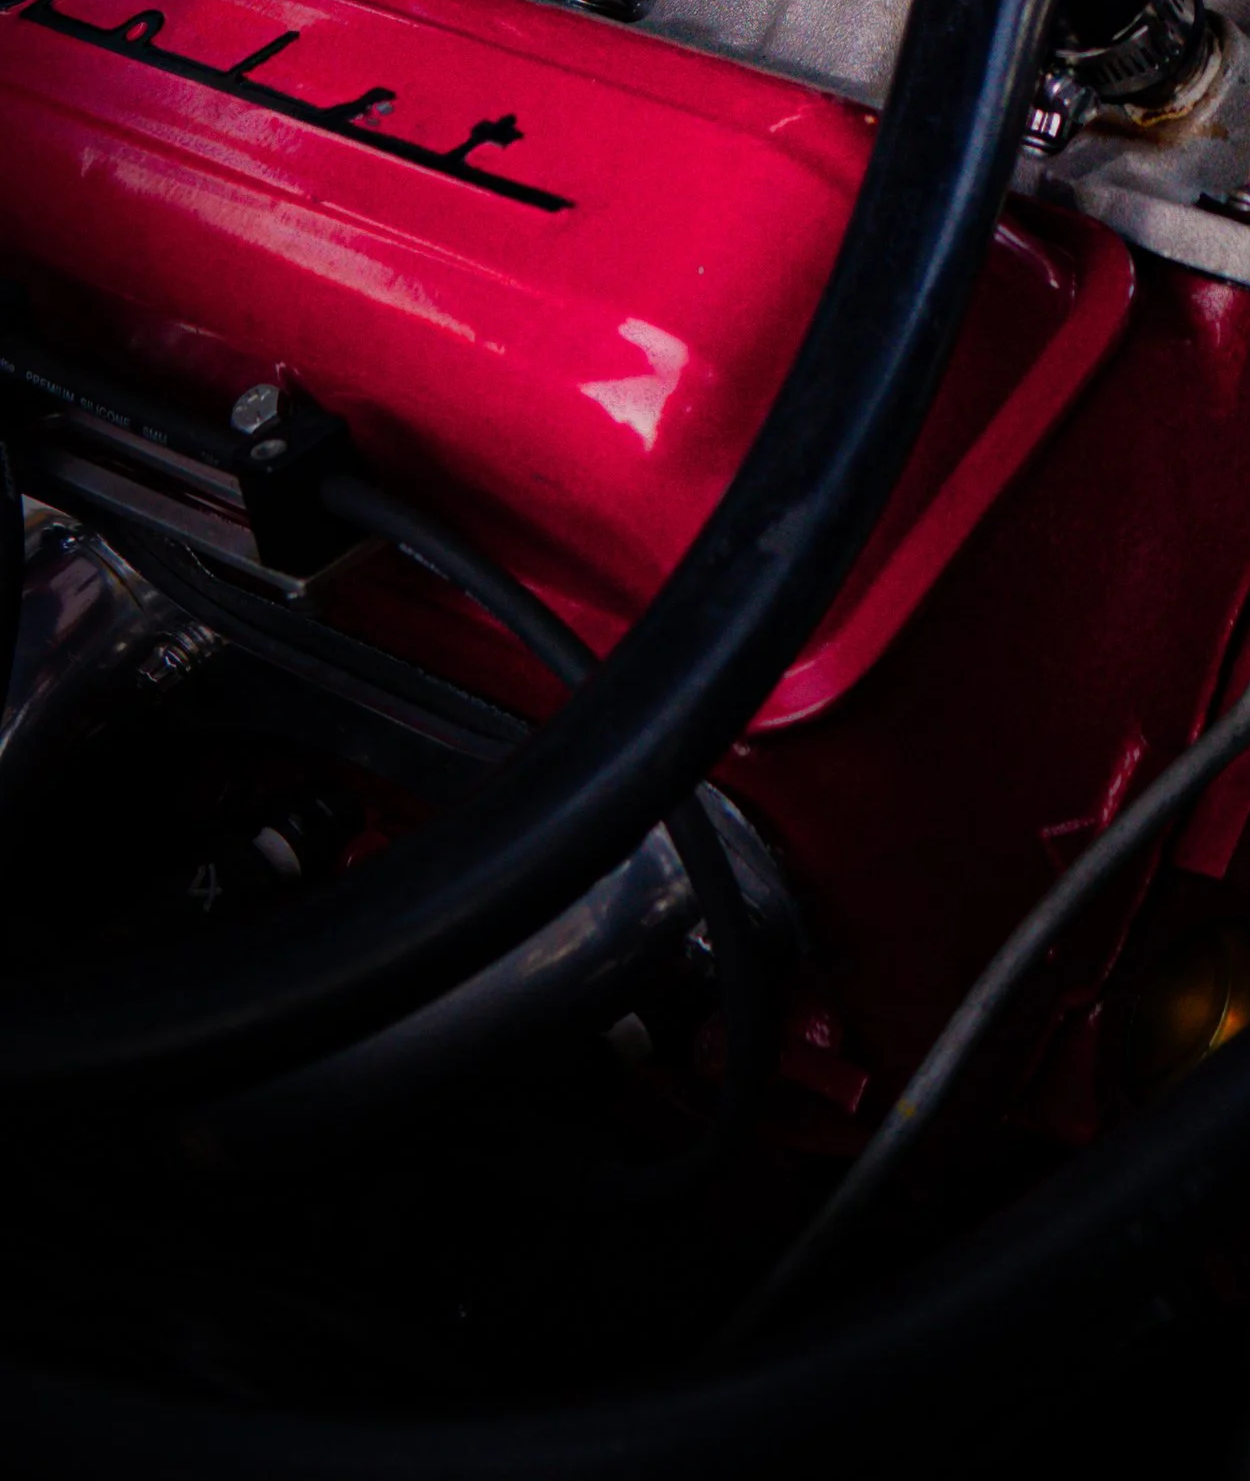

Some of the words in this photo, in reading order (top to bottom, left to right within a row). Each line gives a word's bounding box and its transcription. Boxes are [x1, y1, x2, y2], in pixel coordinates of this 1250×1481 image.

[25, 368, 75, 403] PREMIUM
[79, 396, 132, 428] SILICONE
[186, 862, 224, 914] 4
